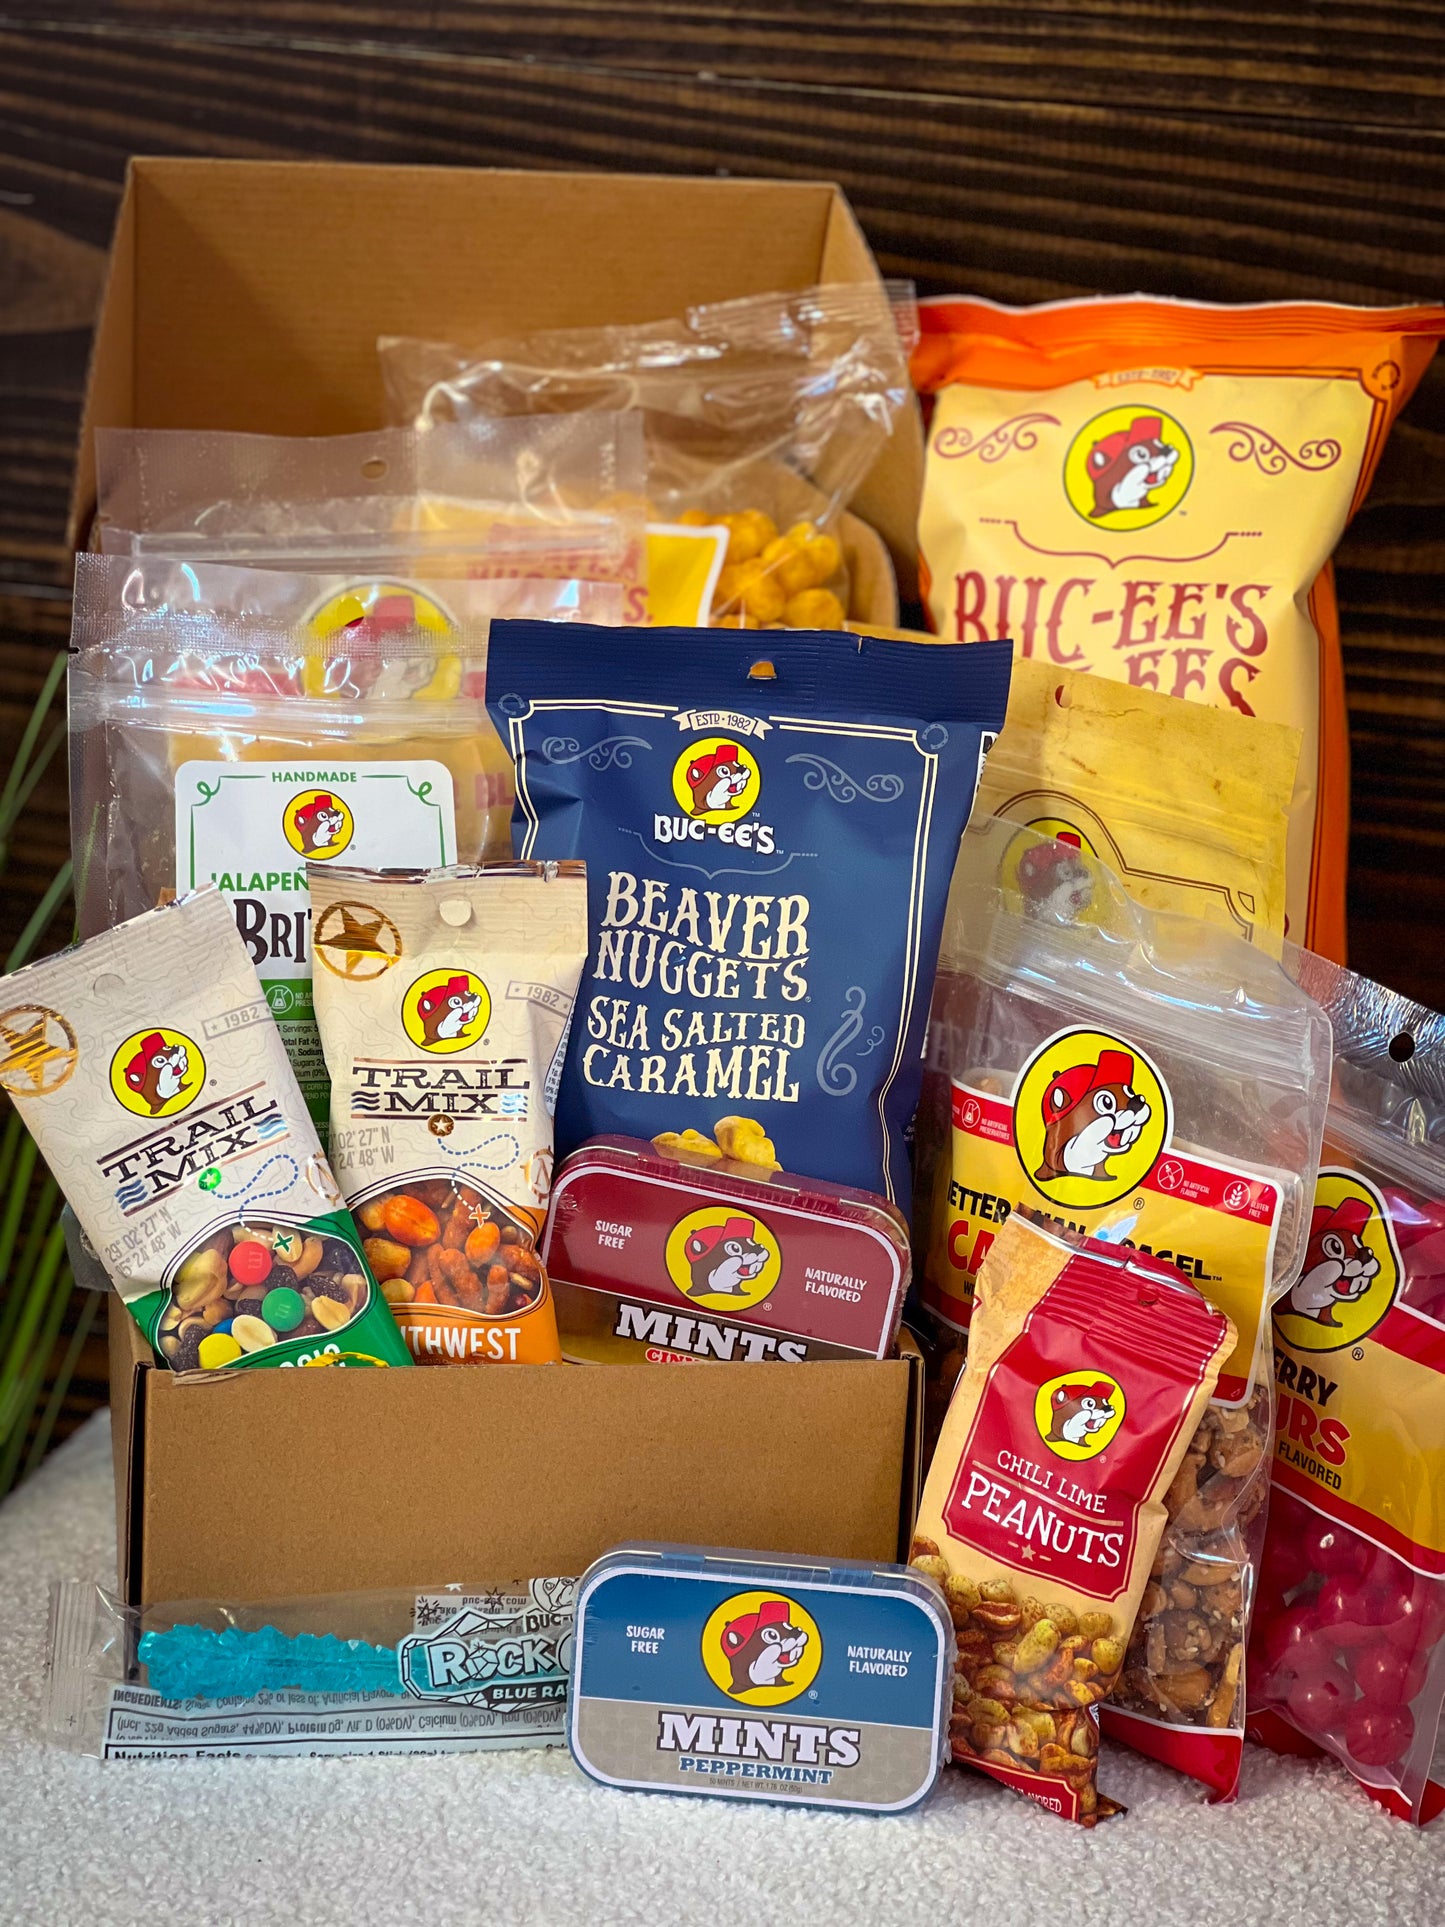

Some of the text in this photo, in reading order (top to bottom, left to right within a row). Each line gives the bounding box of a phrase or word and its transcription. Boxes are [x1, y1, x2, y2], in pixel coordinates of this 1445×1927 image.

[954, 570, 1273, 664] BUC-EE'S
[272, 771, 357, 783] HANDMADE
[654, 814, 775, 855] BUC-EE'S
[601, 871, 810, 960] BEAVER
[233, 898, 313, 966] BRI
[592, 929, 809, 1002] NUGGETS
[528, 986, 560, 1007] 1982
[224, 1006, 261, 1029] 1982
[587, 995, 806, 1052] SEA SALTED
[298, 1038, 310, 1046] Fat
[352, 1066, 530, 1090] TRAIL
[583, 1043, 800, 1103] CARAMEL
[383, 1091, 498, 1114] MIX
[102, 1095, 278, 1184] TRAIL
[381, 1126, 391, 1144] N
[145, 1126, 258, 1194] MIX
[380, 1145, 394, 1164] W
[947, 1179, 1012, 1226] ETTER
[1248, 1208, 1262, 1218] FREE
[158, 1206, 173, 1224] N
[167, 1220, 182, 1240] W
[595, 1220, 633, 1238] SUGAR
[598, 1234, 626, 1250] FREE
[804, 1267, 868, 1291] NATURALLY
[805, 1281, 862, 1304] FLAVORED
[615, 1303, 807, 1362] MINTS
[1278, 1439, 1342, 1490] FLAVORED
[997, 1450, 1108, 1514] CHILI LIME
[961, 1470, 1124, 1568] PEANUTS
[626, 1624, 665, 1641] SUGAR
[631, 1640, 659, 1655] FREE
[847, 1645, 913, 1664] NATURALLY
[848, 1659, 909, 1678] FLAVORED
[492, 1686, 538, 1700] BLUE
[658, 1710, 860, 1768] MINTS
[679, 1757, 833, 1785] PEPPERMINT
